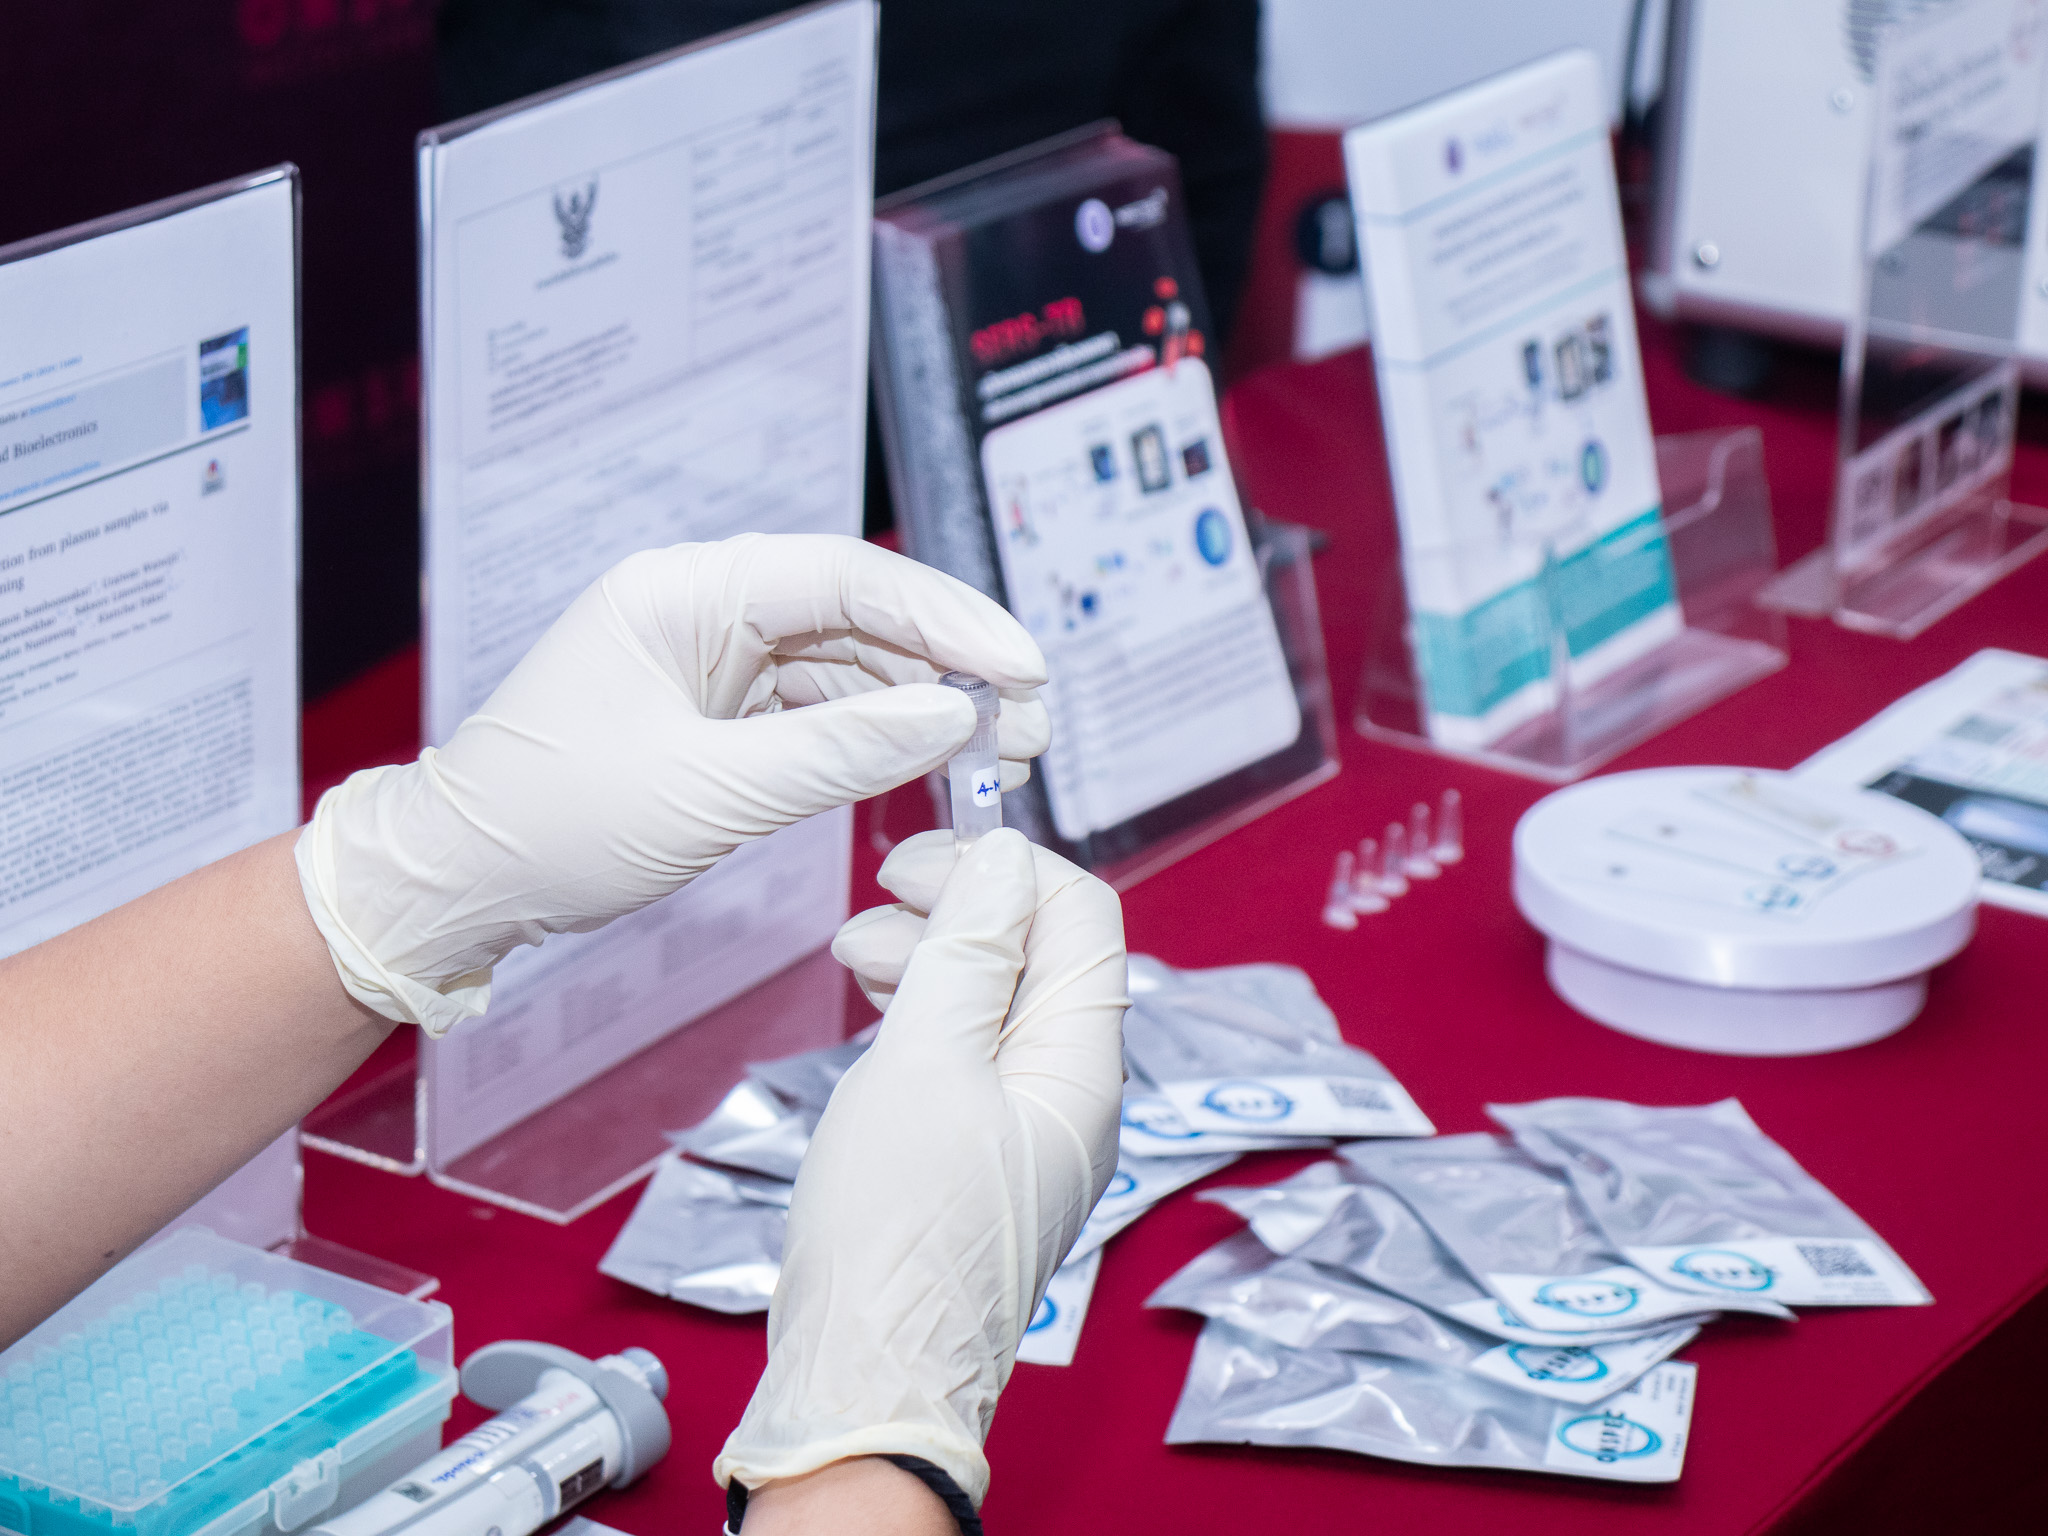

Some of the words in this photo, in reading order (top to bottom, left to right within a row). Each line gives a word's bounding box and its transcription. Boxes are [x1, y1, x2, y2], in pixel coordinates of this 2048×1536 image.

[14, 420, 98, 460] Bioelectronics
[29, 540, 56, 561] from
[60, 525, 100, 554] plasma
[104, 505, 149, 534] samples
